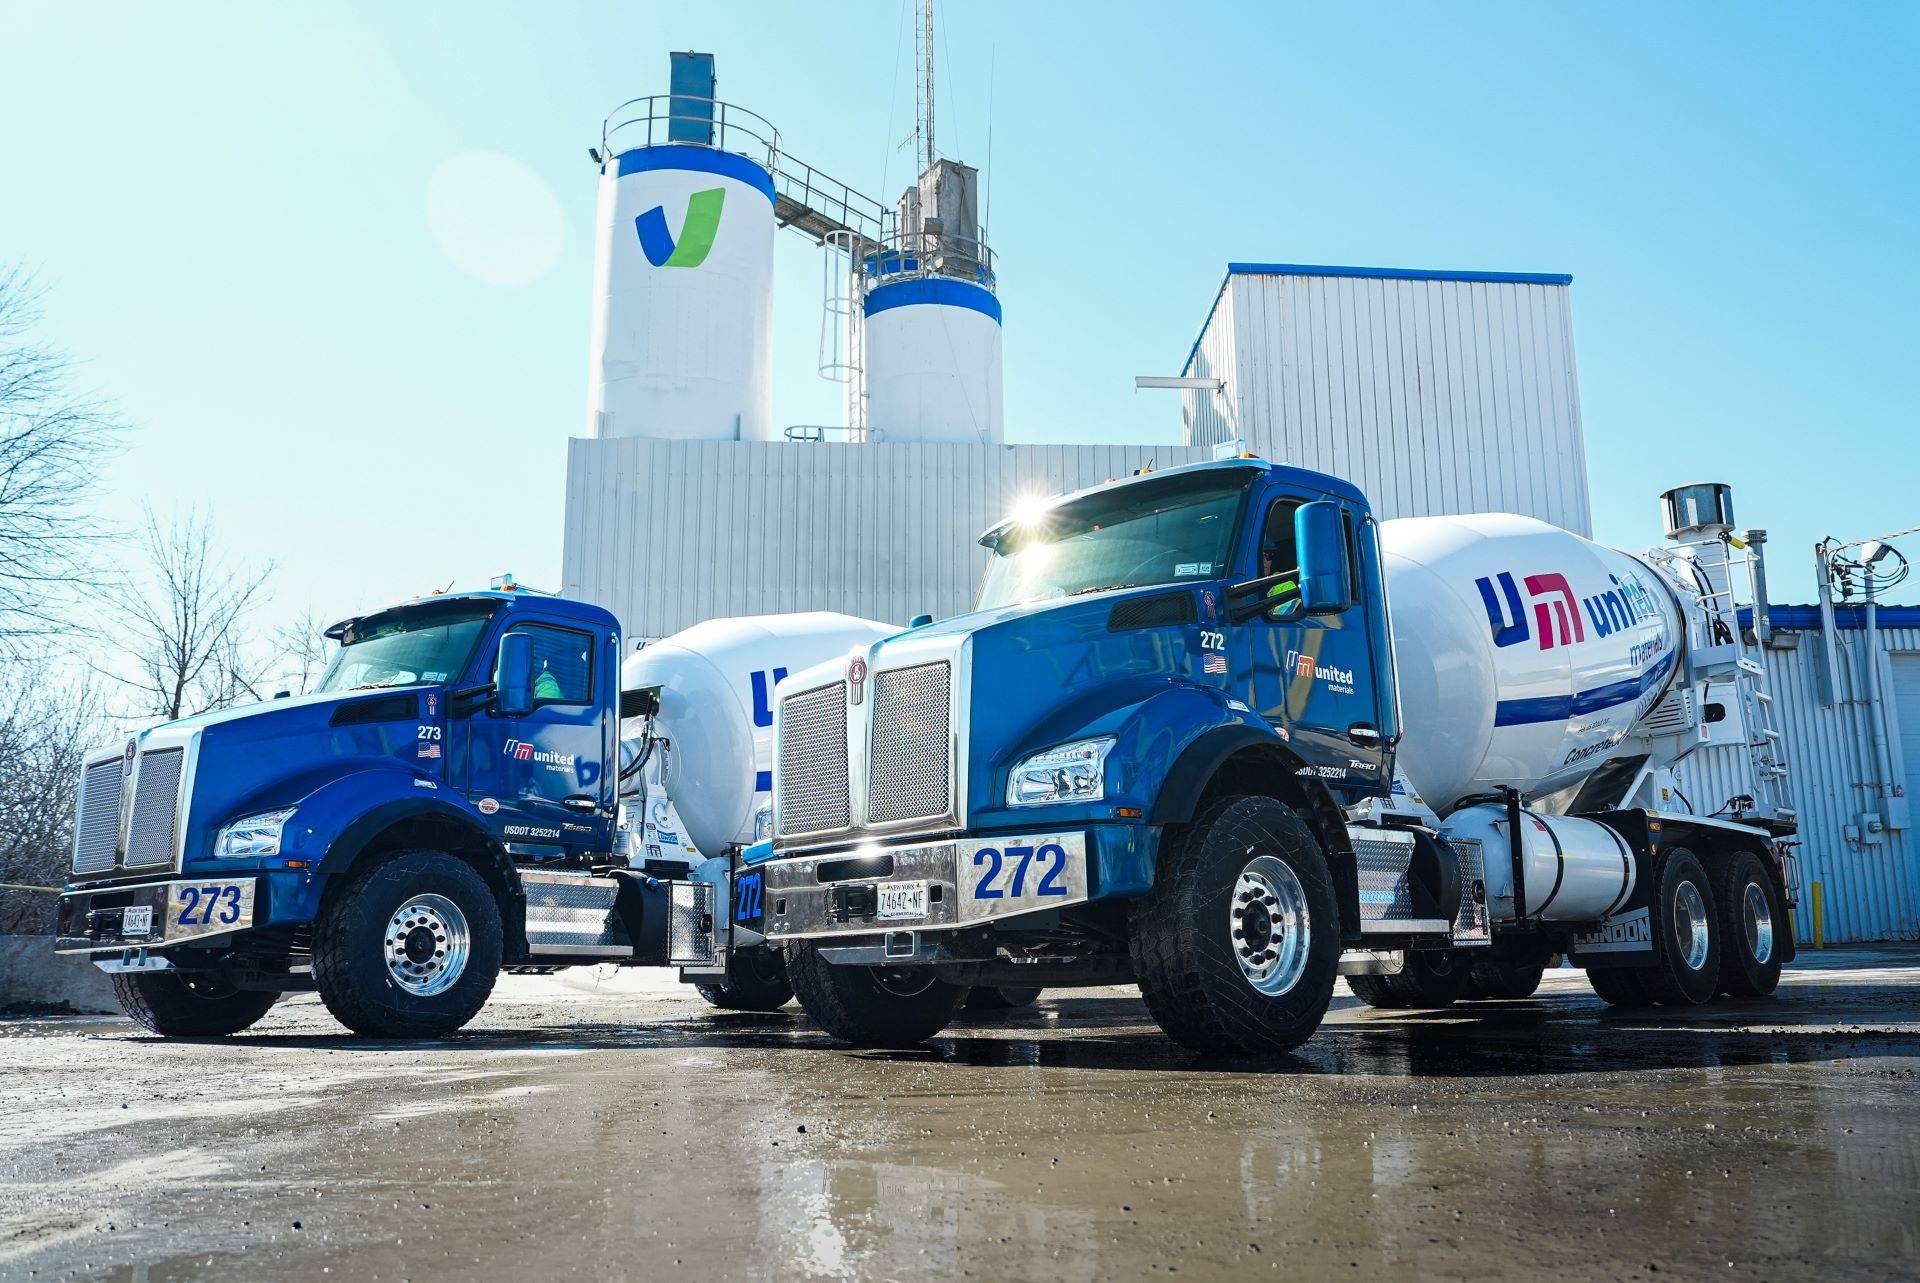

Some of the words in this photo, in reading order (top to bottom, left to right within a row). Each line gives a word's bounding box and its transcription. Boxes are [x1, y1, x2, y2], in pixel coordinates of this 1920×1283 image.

[1200, 631, 1225, 650] 272
[1314, 665, 1353, 685] united
[1327, 684, 1355, 695] materials
[417, 725, 442, 740] 273
[533, 751, 575, 766] united
[546, 764, 575, 774] materials
[1317, 766, 1347, 779] 3252214
[504, 825, 529, 836] USDOT
[530, 827, 560, 838] 3252214
[973, 843, 1068, 900] 272
[737, 872, 762, 921] 272
[178, 885, 241, 925] 273
